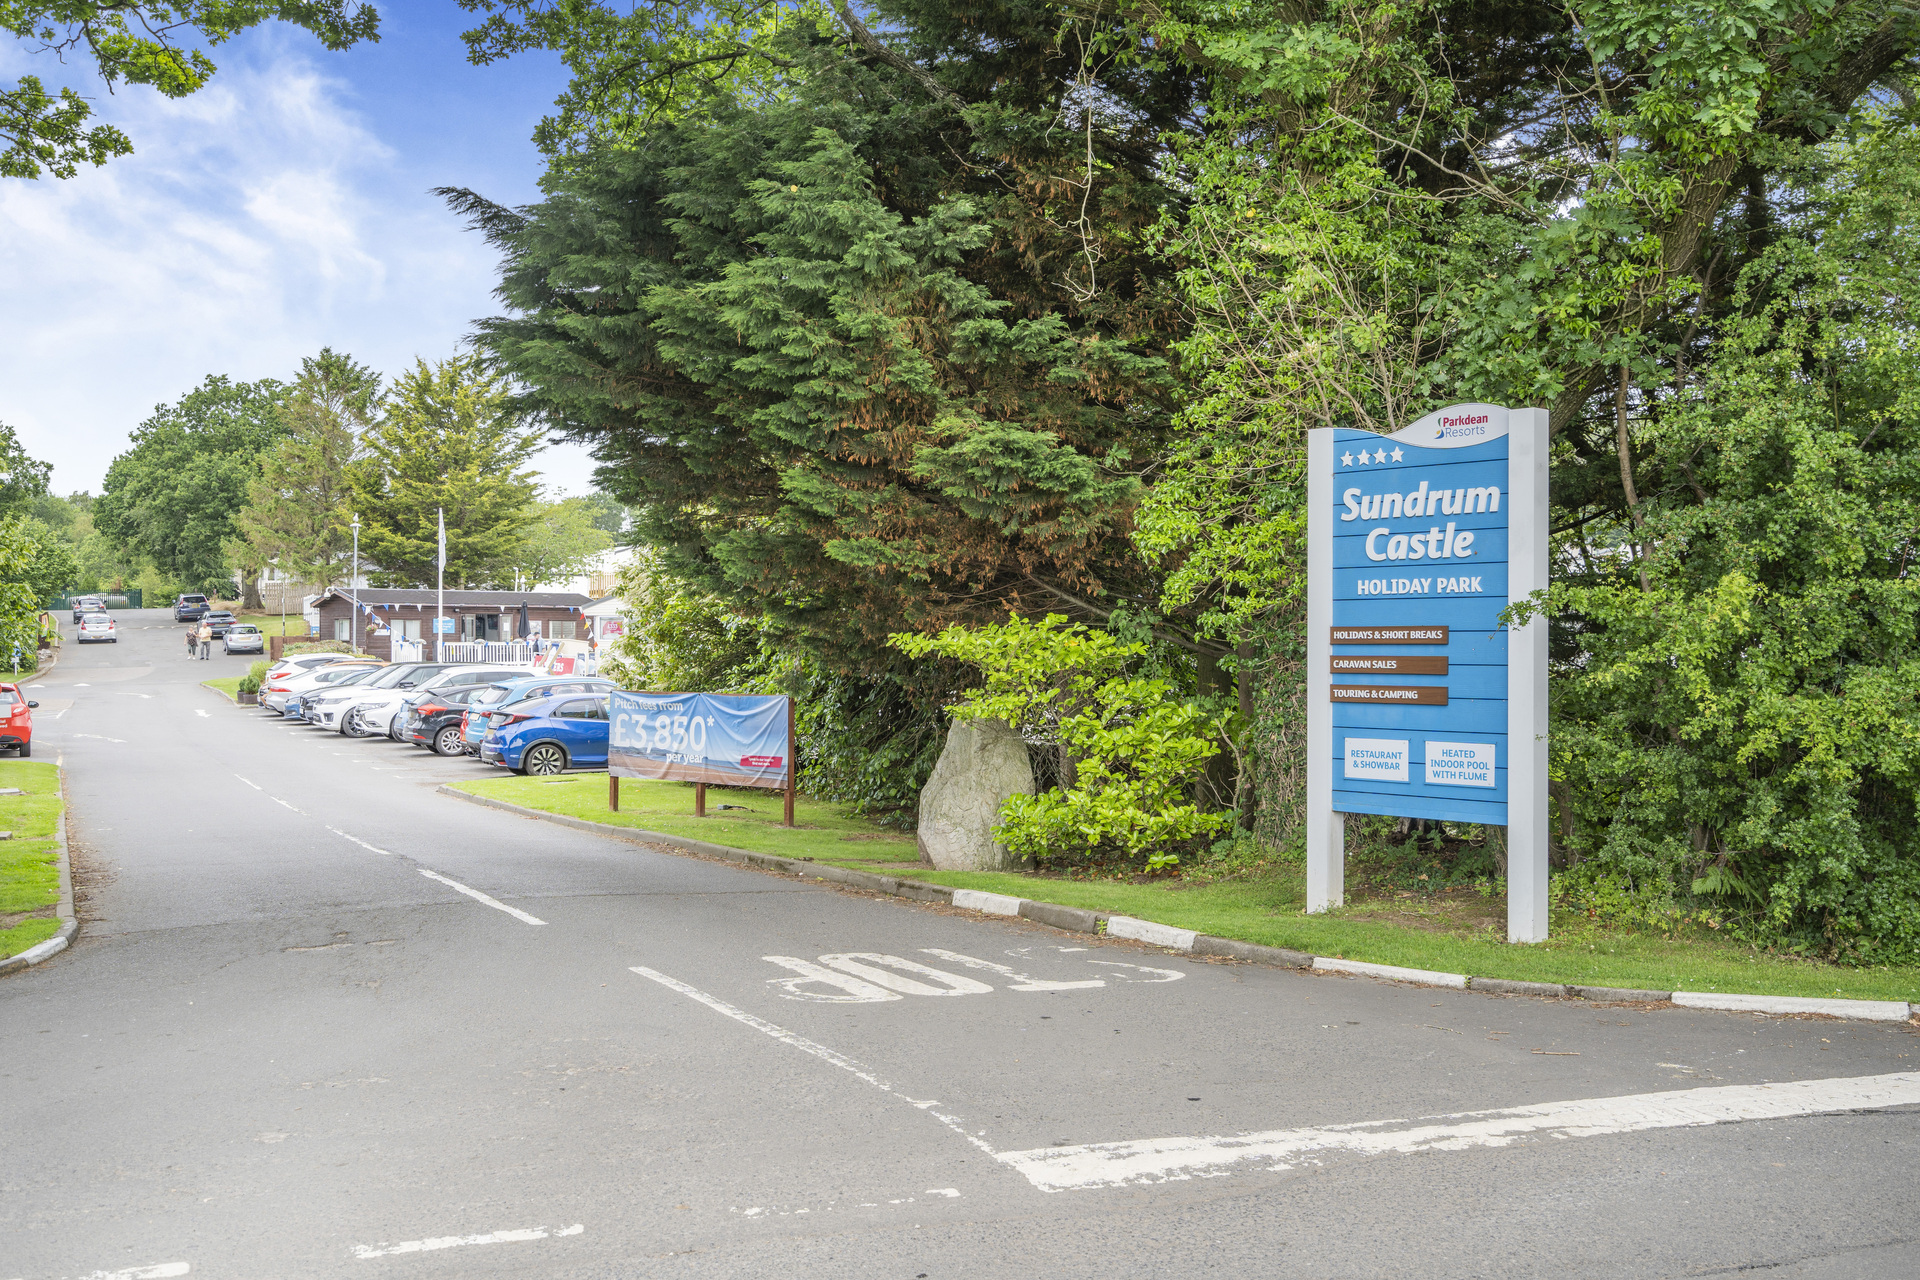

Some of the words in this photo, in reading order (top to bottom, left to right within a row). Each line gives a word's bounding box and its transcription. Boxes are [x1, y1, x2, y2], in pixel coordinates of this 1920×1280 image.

[1443, 414, 1488, 427] Parkdean
[1445, 426, 1485, 437] Resorts
[1341, 481, 1501, 521] Sundrum
[1365, 522, 1474, 561] Castle
[1357, 578, 1431, 595] HOLIDAY
[1437, 576, 1483, 593] PARK
[1333, 631, 1373, 640] HOLIDAYS
[1374, 631, 1381, 639] &
[1381, 631, 1409, 639] SHORT
[1410, 630, 1443, 639] BREAKS
[1333, 660, 1371, 669] CARAVAN
[1372, 660, 1397, 669] SALES
[1333, 689, 1370, 698] TOURING
[1371, 690, 1378, 698] &
[1379, 690, 1418, 699] CAMPING
[615, 698, 639, 710] Pitch
[639, 700, 657, 710] fees
[659, 701, 683, 711] from
[666, 753, 682, 764] per
[683, 754, 704, 766] year
[1351, 749, 1402, 760] RESTAURANT
[1442, 749, 1475, 759] HEATED
[1352, 760, 1359, 768] &
[1360, 760, 1400, 770] SHOWBAR
[1430, 759, 1465, 769] INDOOR
[1467, 761, 1490, 770] POOL
[1432, 770, 1456, 779] WITH
[1458, 771, 1488, 781] FLUME
